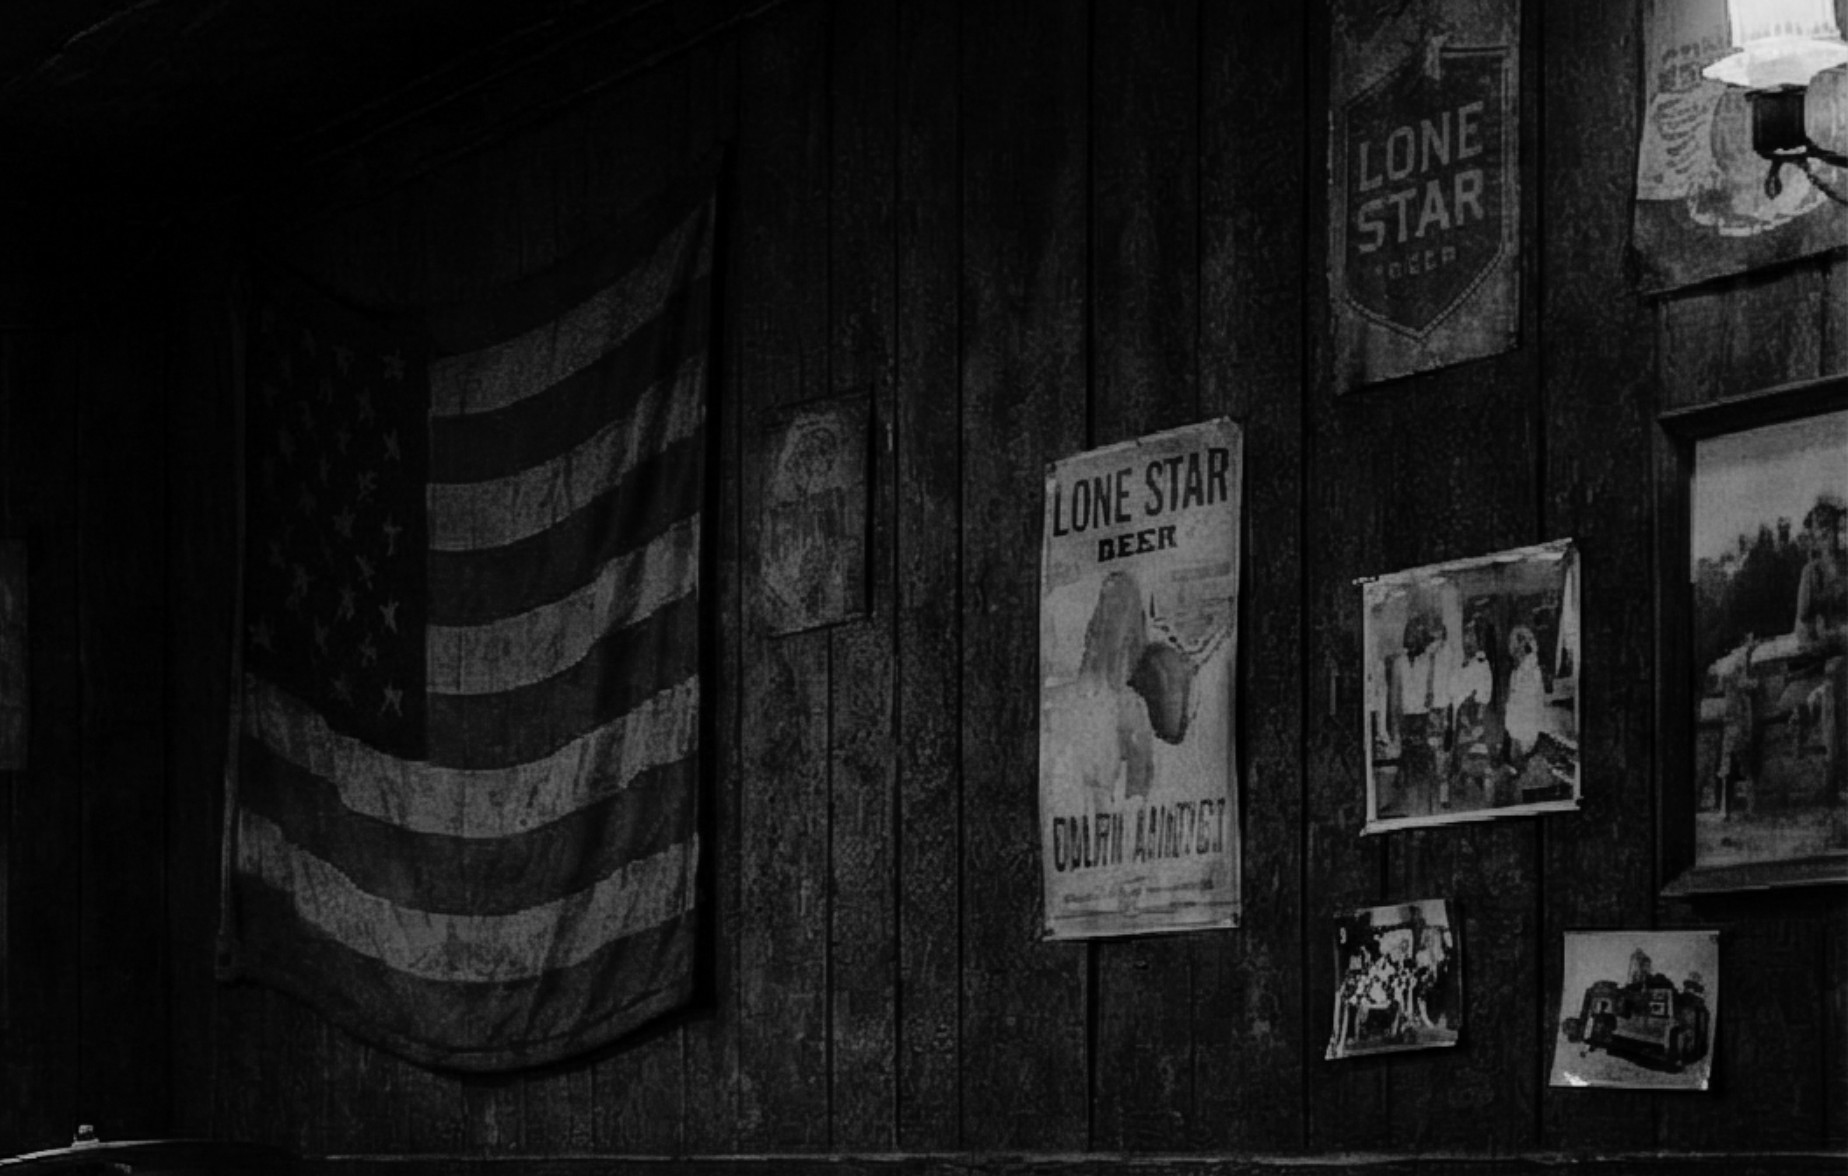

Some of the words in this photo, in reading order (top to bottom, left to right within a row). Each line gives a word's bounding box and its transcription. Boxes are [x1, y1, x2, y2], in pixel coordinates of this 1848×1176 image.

[1358, 100, 1485, 193] LONE
[1357, 168, 1485, 254] STAR
[1053, 466, 1133, 537] LONE
[1144, 447, 1229, 516] STAR
[1097, 524, 1178, 562] BEER
